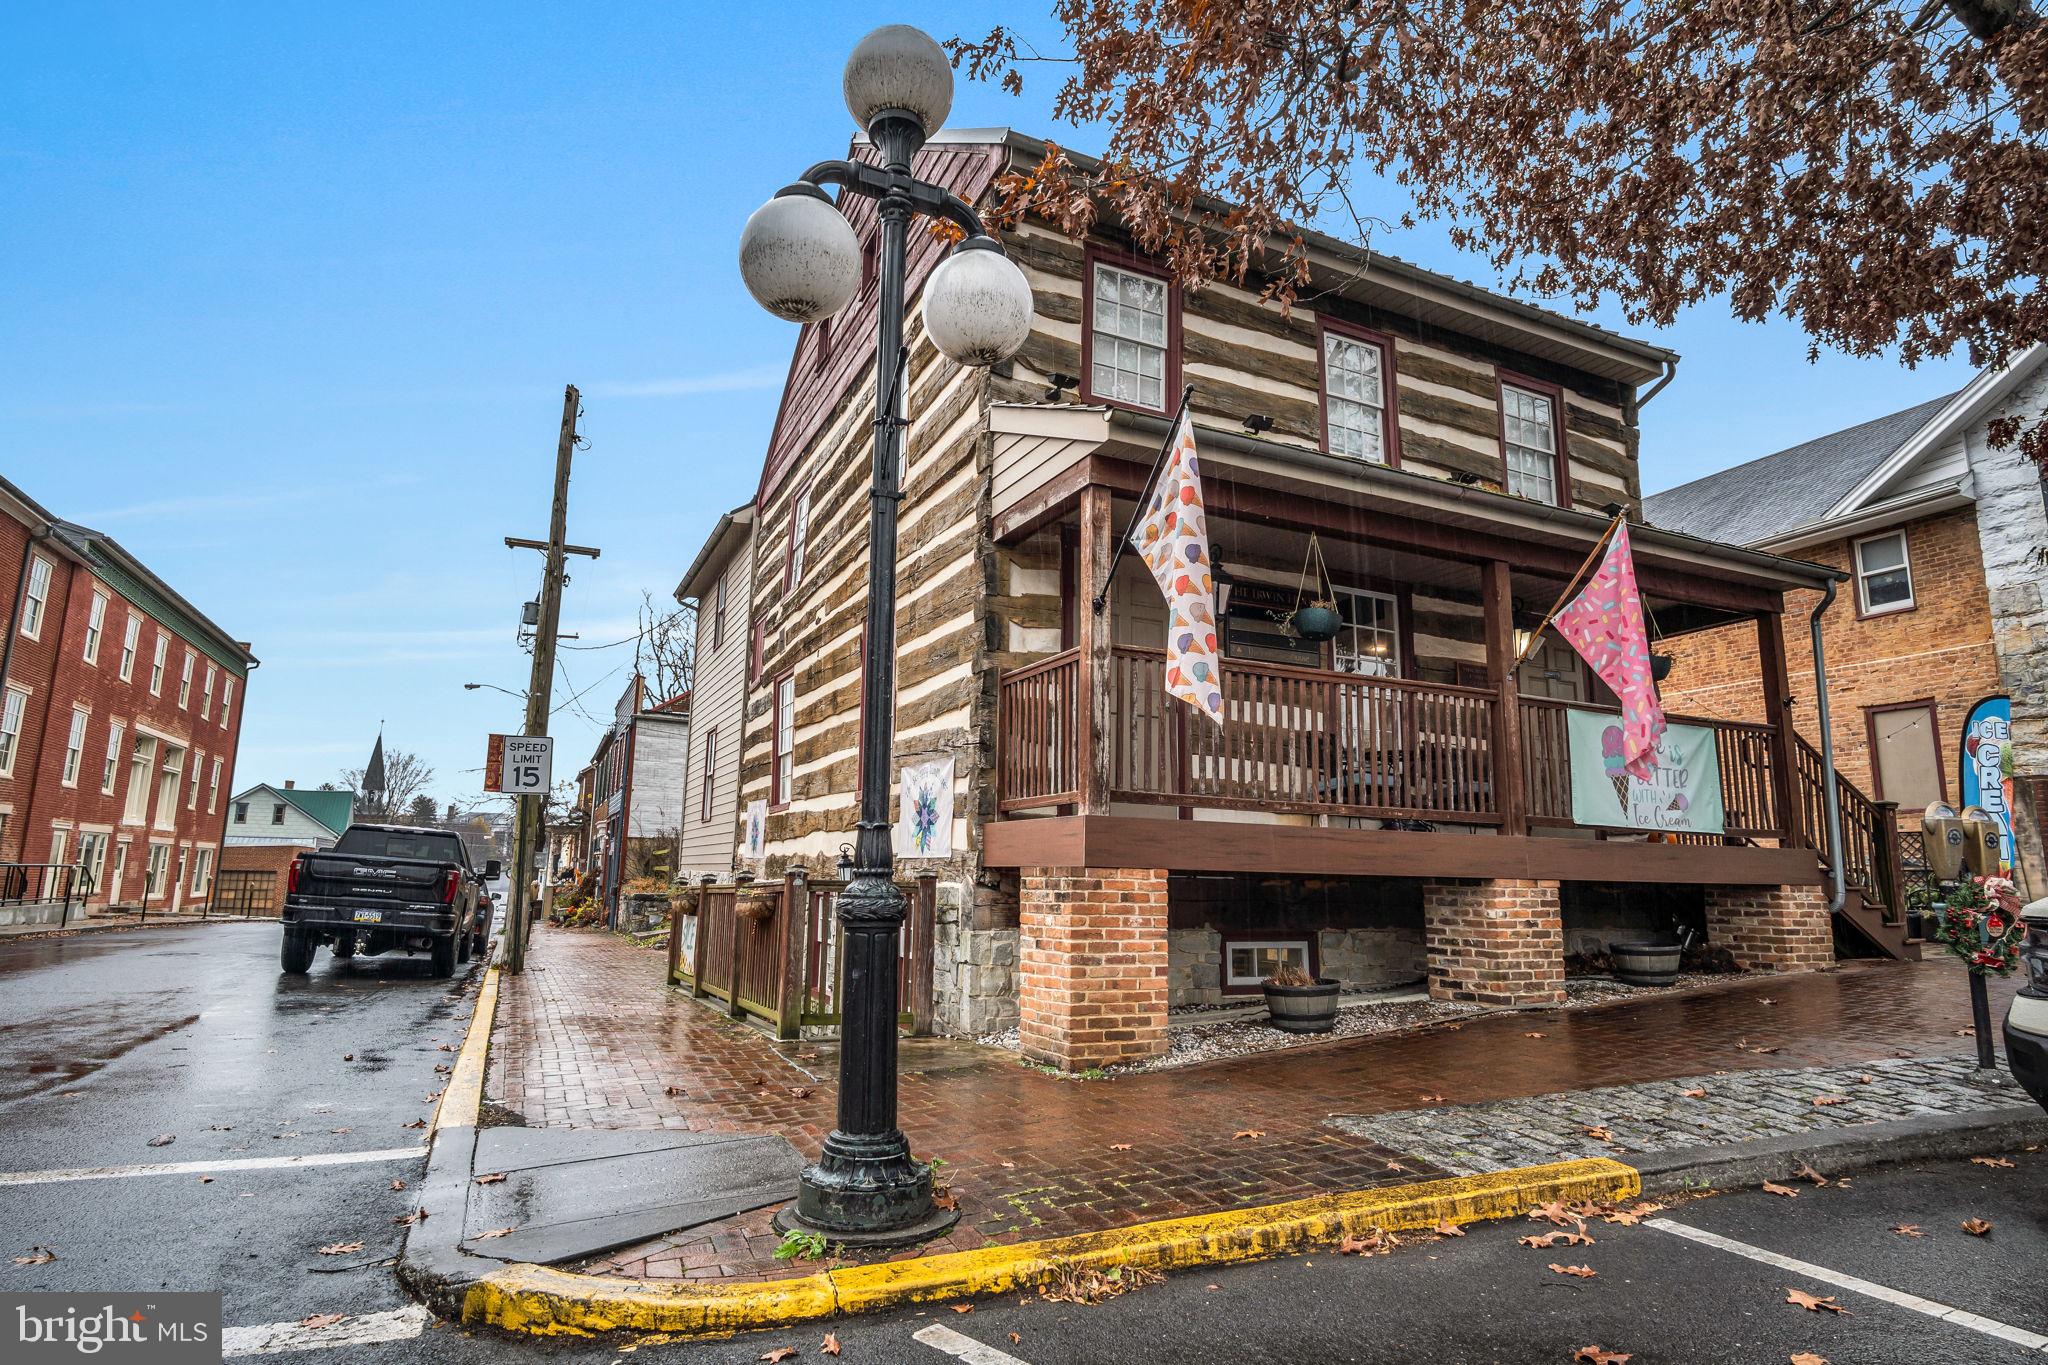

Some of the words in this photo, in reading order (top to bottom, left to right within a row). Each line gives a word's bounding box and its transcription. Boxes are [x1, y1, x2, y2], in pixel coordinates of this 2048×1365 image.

[1972, 721, 2009, 740] ICE
[509, 742, 548, 752] SPEED
[513, 754, 542, 764] LIMIT
[513, 766, 540, 788] 15
[1637, 767, 1689, 789] TTER
[1633, 788, 1657, 804] WITH
[1633, 803, 1651, 826] Ice
[1654, 805, 1692, 829] Cream
[353, 867, 397, 879] GMC
[352, 887, 393, 895] DENALI
